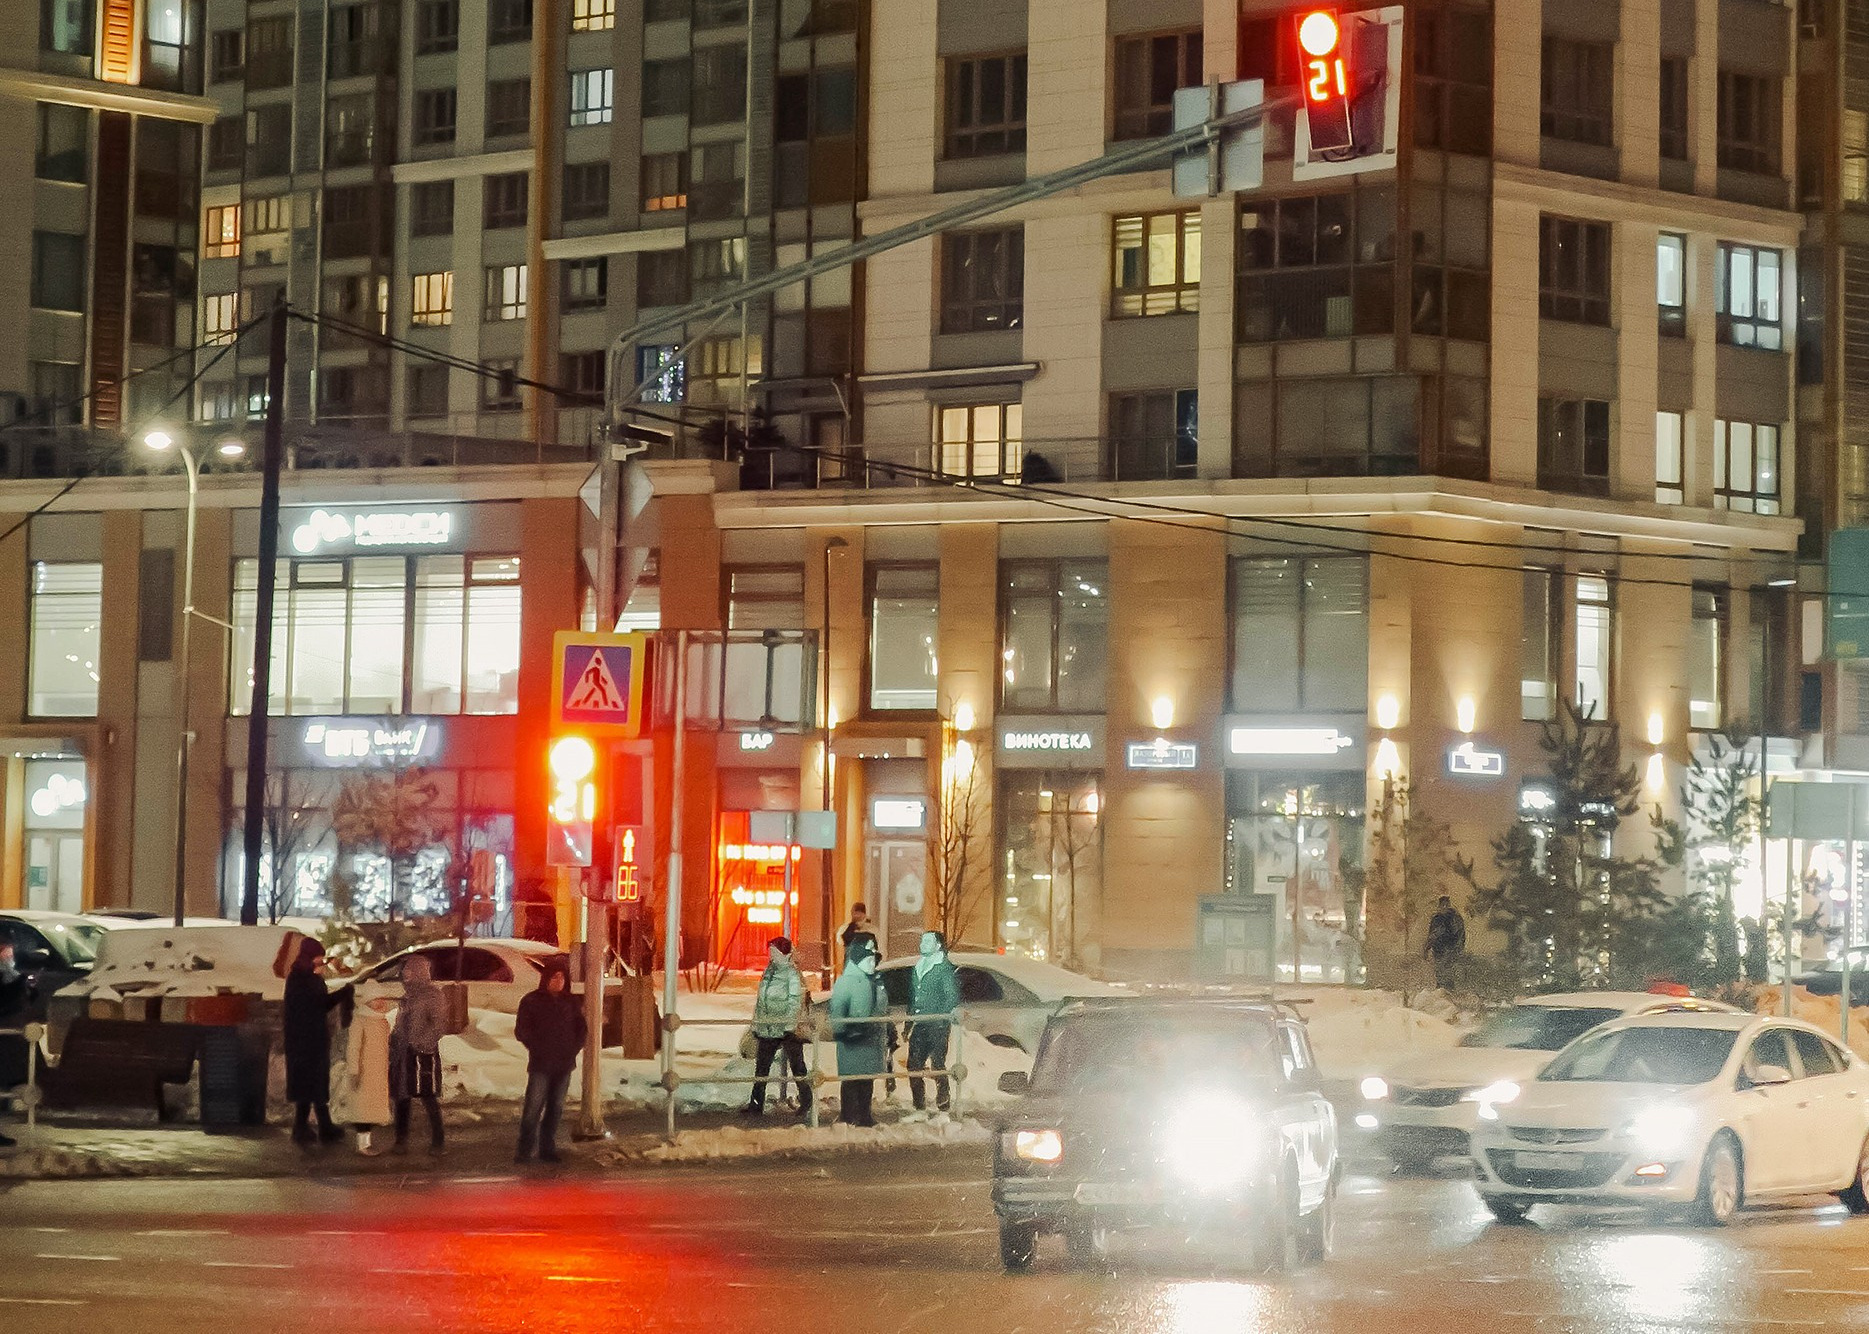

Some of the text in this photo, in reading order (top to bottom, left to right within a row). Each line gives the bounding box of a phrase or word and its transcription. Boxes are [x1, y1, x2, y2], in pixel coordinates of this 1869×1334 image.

[1308, 58, 1346, 101] 21
[741, 733, 773, 749] БАР
[1004, 733, 1092, 749] ВИНОТЕКА
[617, 865, 639, 900] 86
